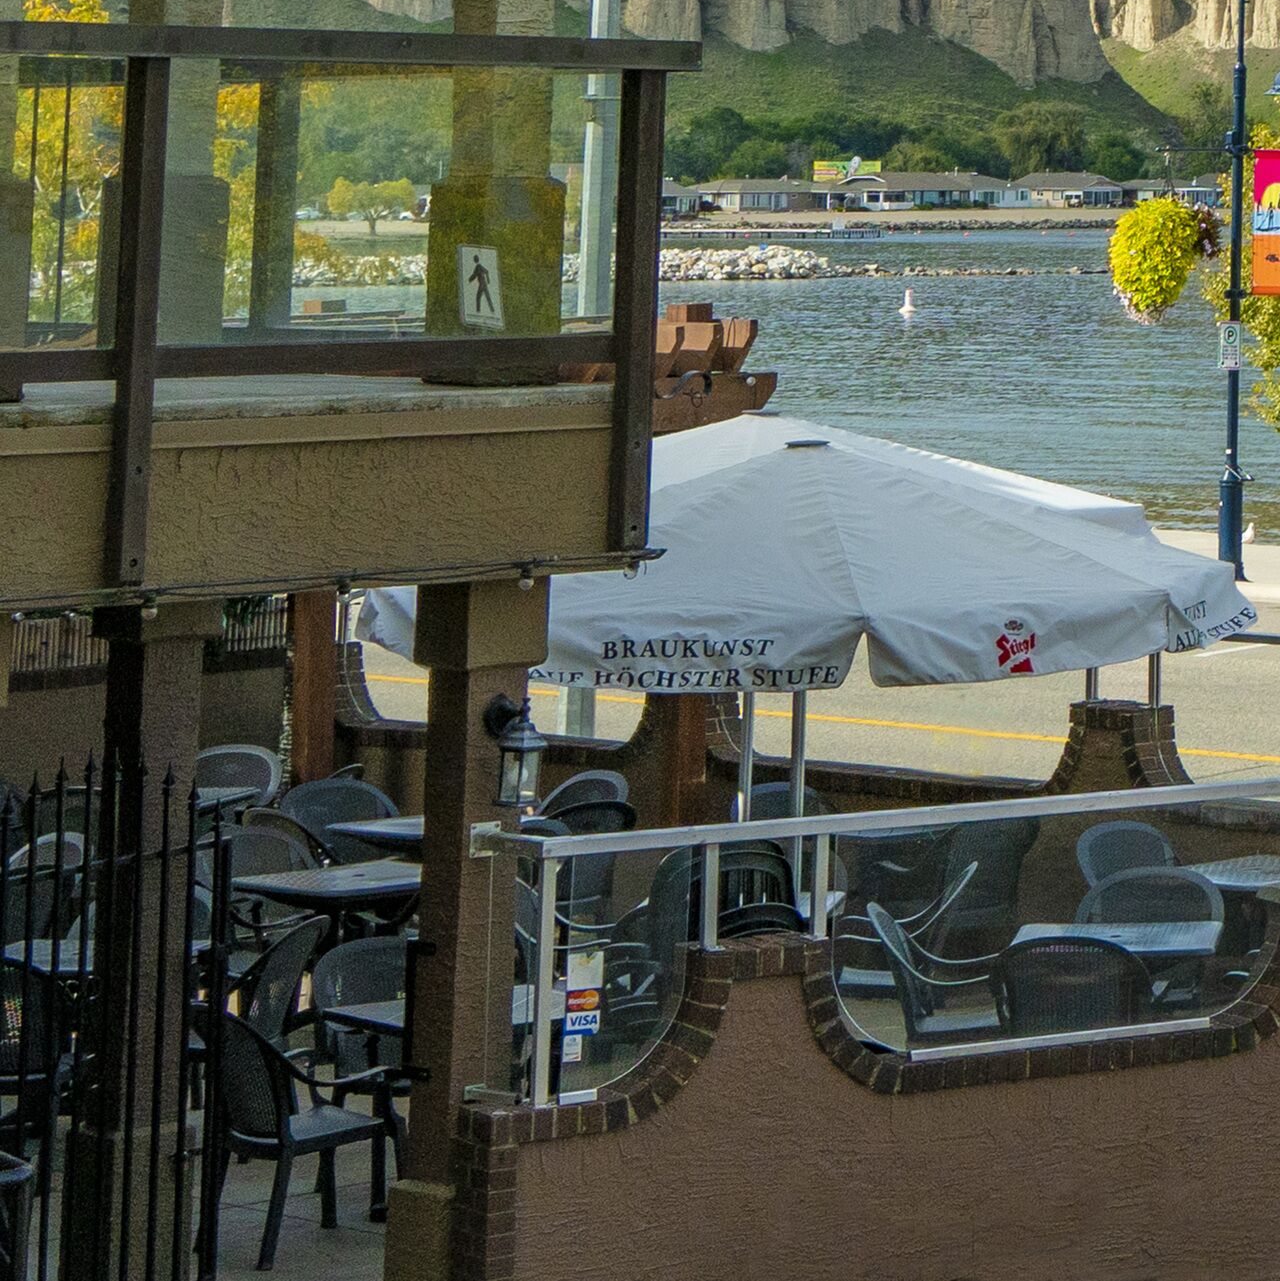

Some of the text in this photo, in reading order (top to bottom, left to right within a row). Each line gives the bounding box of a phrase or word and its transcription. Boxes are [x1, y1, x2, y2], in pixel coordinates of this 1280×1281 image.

[601, 638, 775, 661] BRAUKUNST
[595, 667, 741, 689] HÖCHSTER
[751, 666, 839, 687] STUFE
[569, 1014, 598, 1027] VISA
